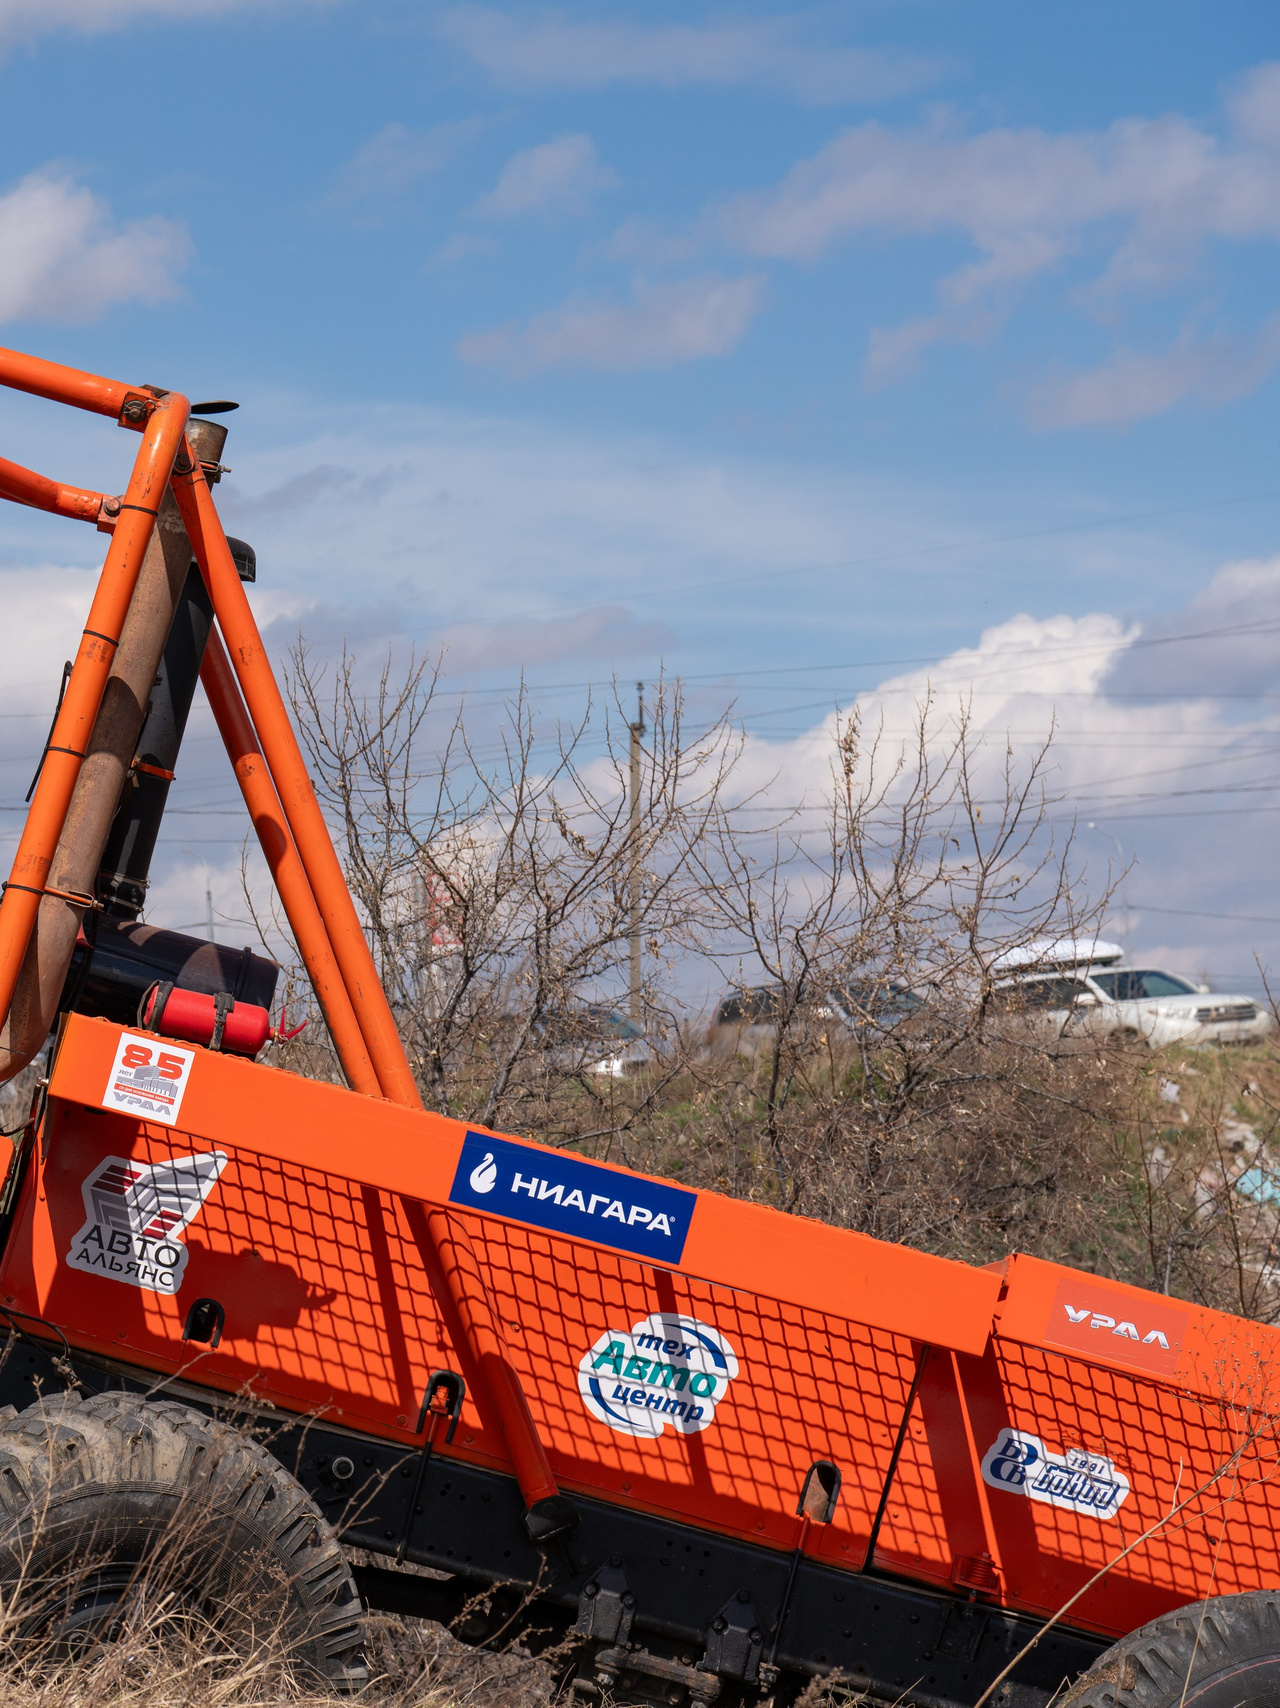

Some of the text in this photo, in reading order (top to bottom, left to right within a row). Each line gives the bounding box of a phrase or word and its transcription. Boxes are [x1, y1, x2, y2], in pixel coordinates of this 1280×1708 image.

[122, 1044, 185, 1080] 85
[113, 1091, 170, 1115] УРАЛ
[511, 1172, 671, 1236] НИАГАРА
[80, 1224, 180, 1269] АВТО
[75, 1247, 174, 1287] АЛЬЯНС
[636, 1332, 698, 1359] тех
[1063, 1304, 1170, 1349] УРАЛ
[591, 1339, 717, 1398] Авто
[612, 1383, 704, 1423] центр
[1071, 1457, 1105, 1474] 1991
